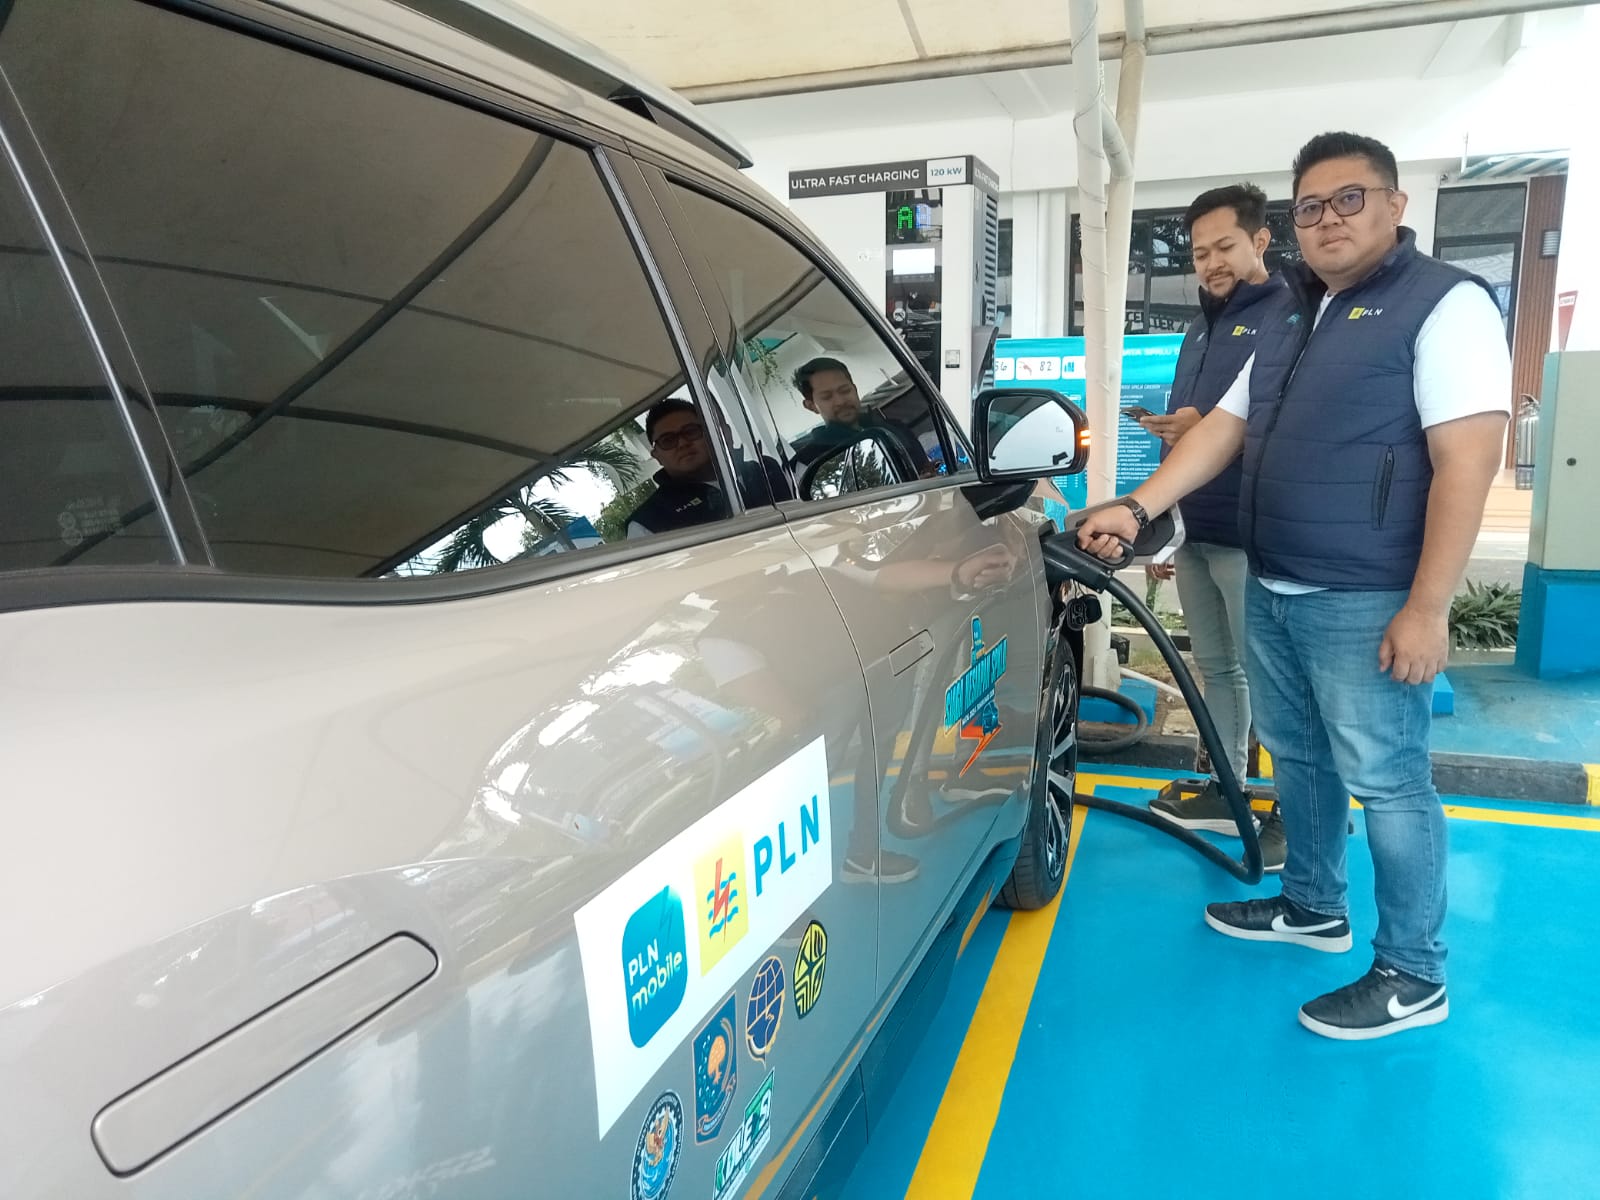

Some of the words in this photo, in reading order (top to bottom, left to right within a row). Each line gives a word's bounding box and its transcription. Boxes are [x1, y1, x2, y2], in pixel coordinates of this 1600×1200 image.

[791, 177, 826, 189] ULTRA
[829, 174, 857, 187] FAST
[859, 169, 920, 184] CHARGING
[930, 168, 945, 177] 120
[947, 167, 962, 175] kW
[897, 206, 913, 229] A
[1362, 308, 1384, 317] PLN
[753, 794, 820, 898] PLN
[628, 938, 659, 987] PLN
[632, 951, 683, 1016] mobile
